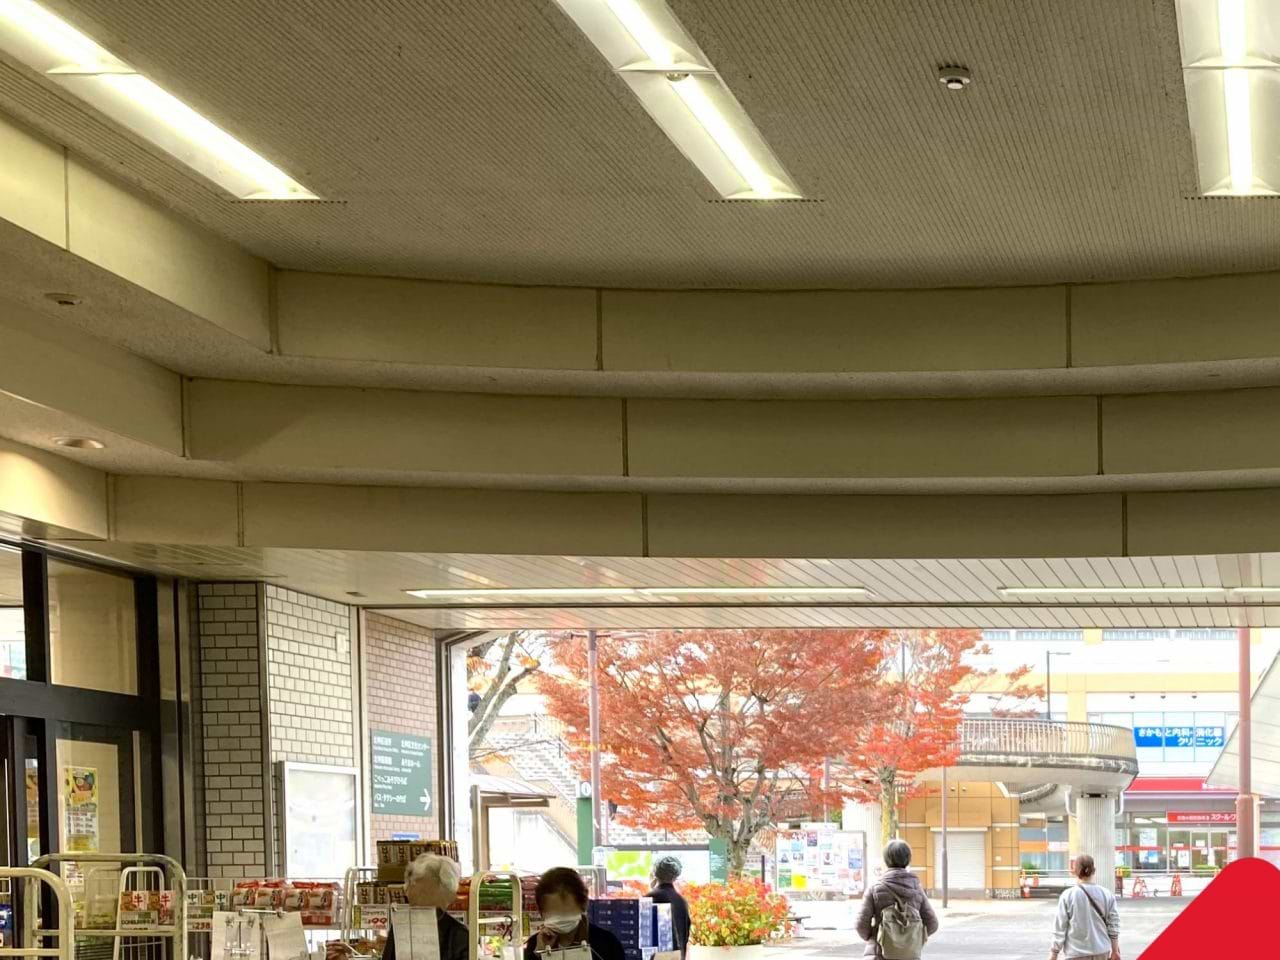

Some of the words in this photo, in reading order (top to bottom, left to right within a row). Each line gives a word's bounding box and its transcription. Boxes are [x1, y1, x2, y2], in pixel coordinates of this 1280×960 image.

[1178, 737, 1222, 747] クリニック
